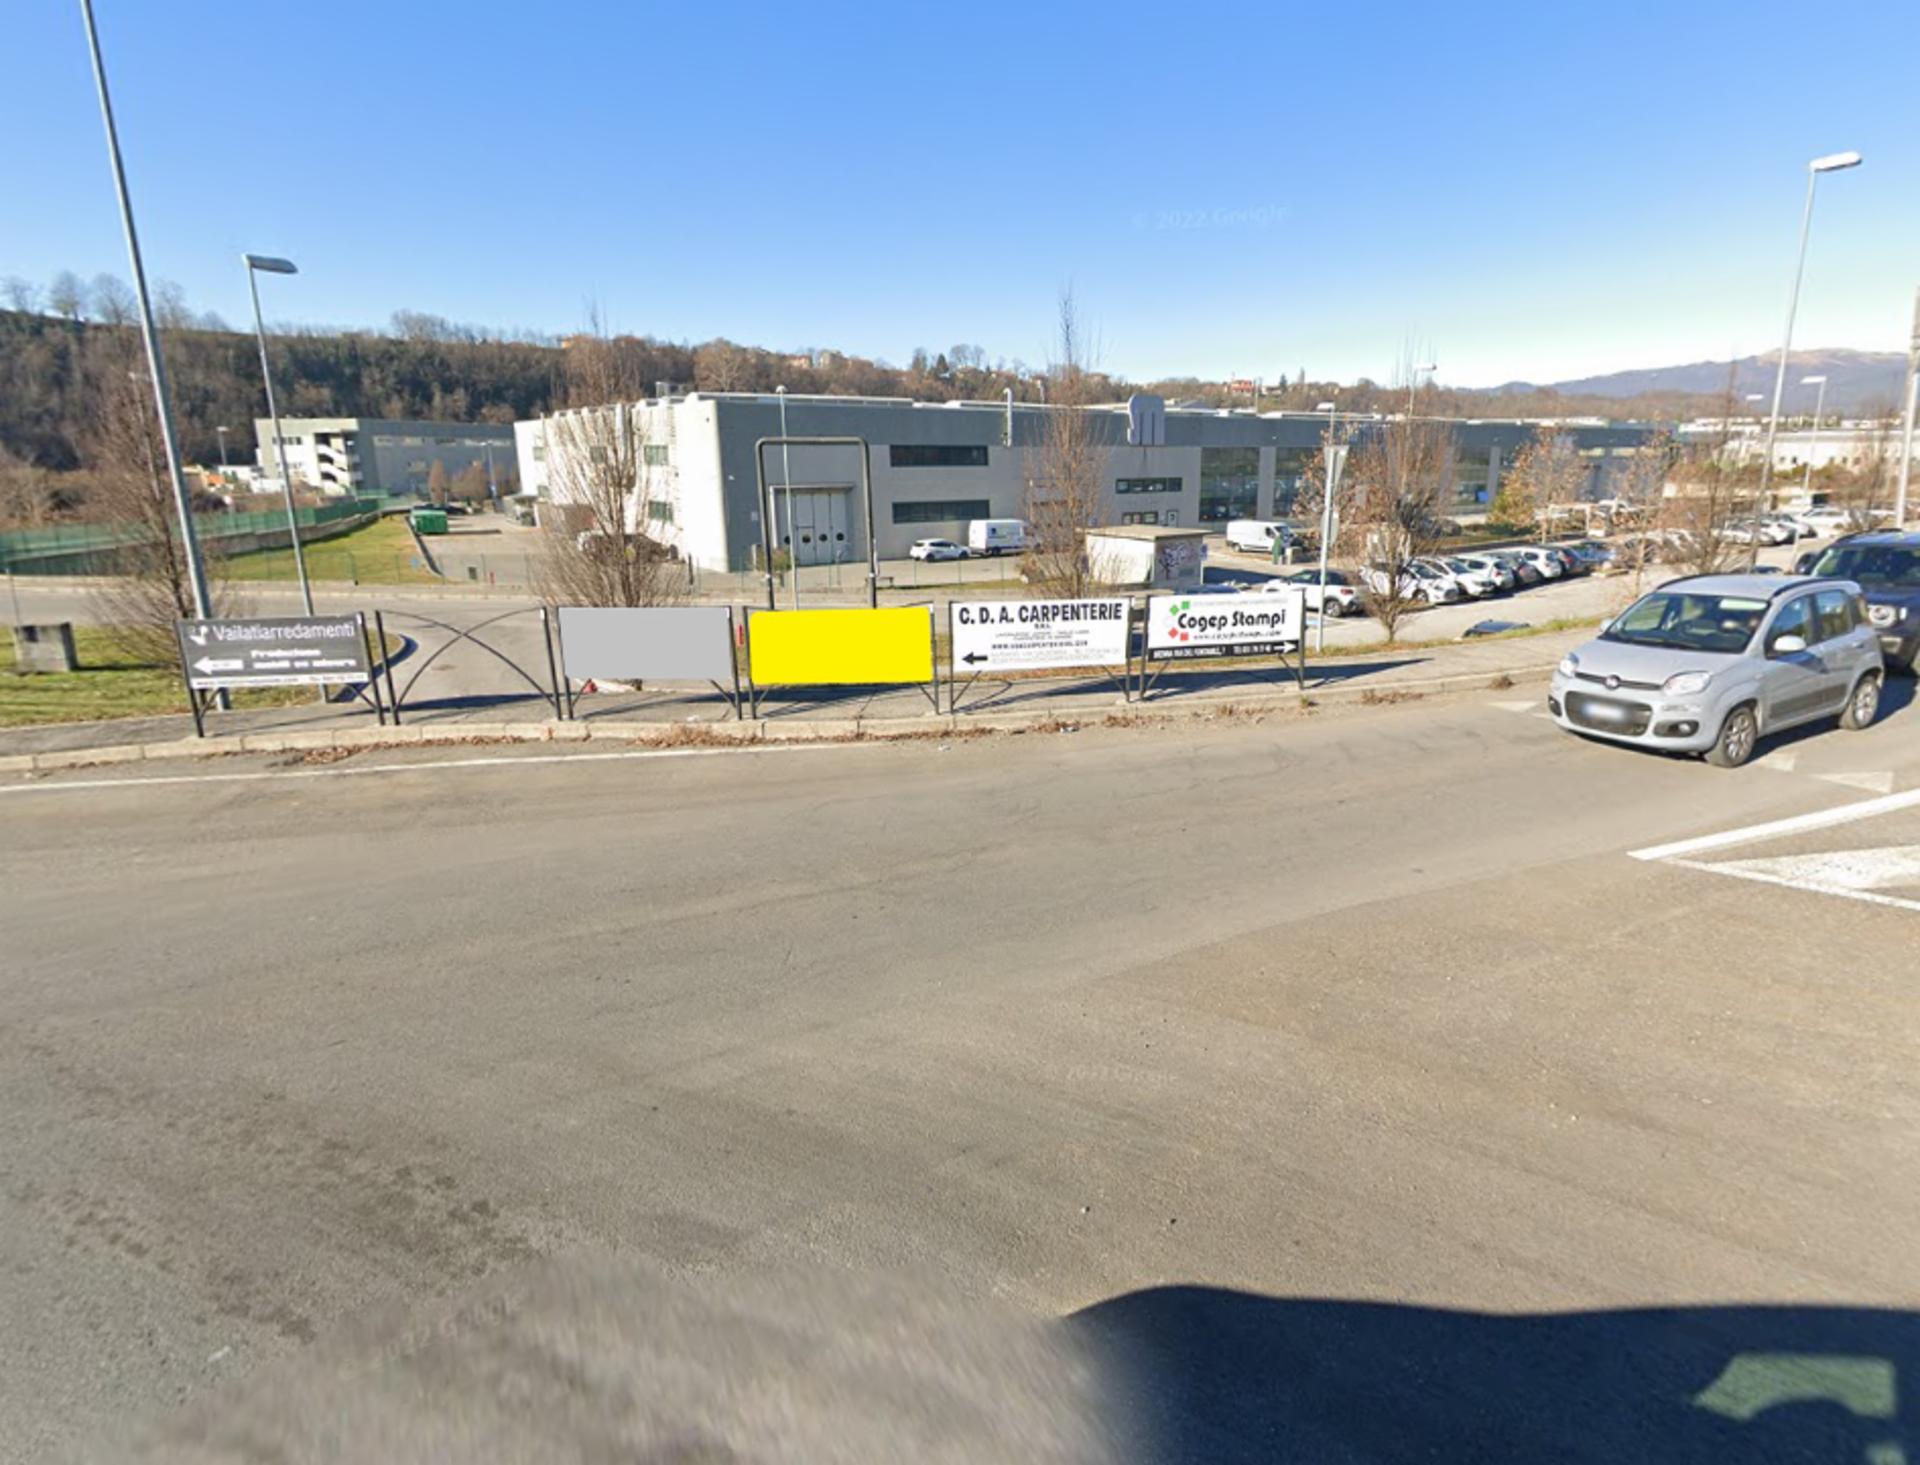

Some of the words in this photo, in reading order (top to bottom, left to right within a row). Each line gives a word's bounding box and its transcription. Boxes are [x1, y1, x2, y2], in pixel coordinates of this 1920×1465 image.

[959, 607, 975, 624] C.
[979, 607, 995, 624] D.
[999, 606, 1014, 623] A.
[1018, 603, 1123, 622] CARPENTERIE
[1178, 613, 1228, 632] Cogep
[1232, 609, 1286, 628] Stampi
[212, 621, 355, 641] Vailatiarredamenti
